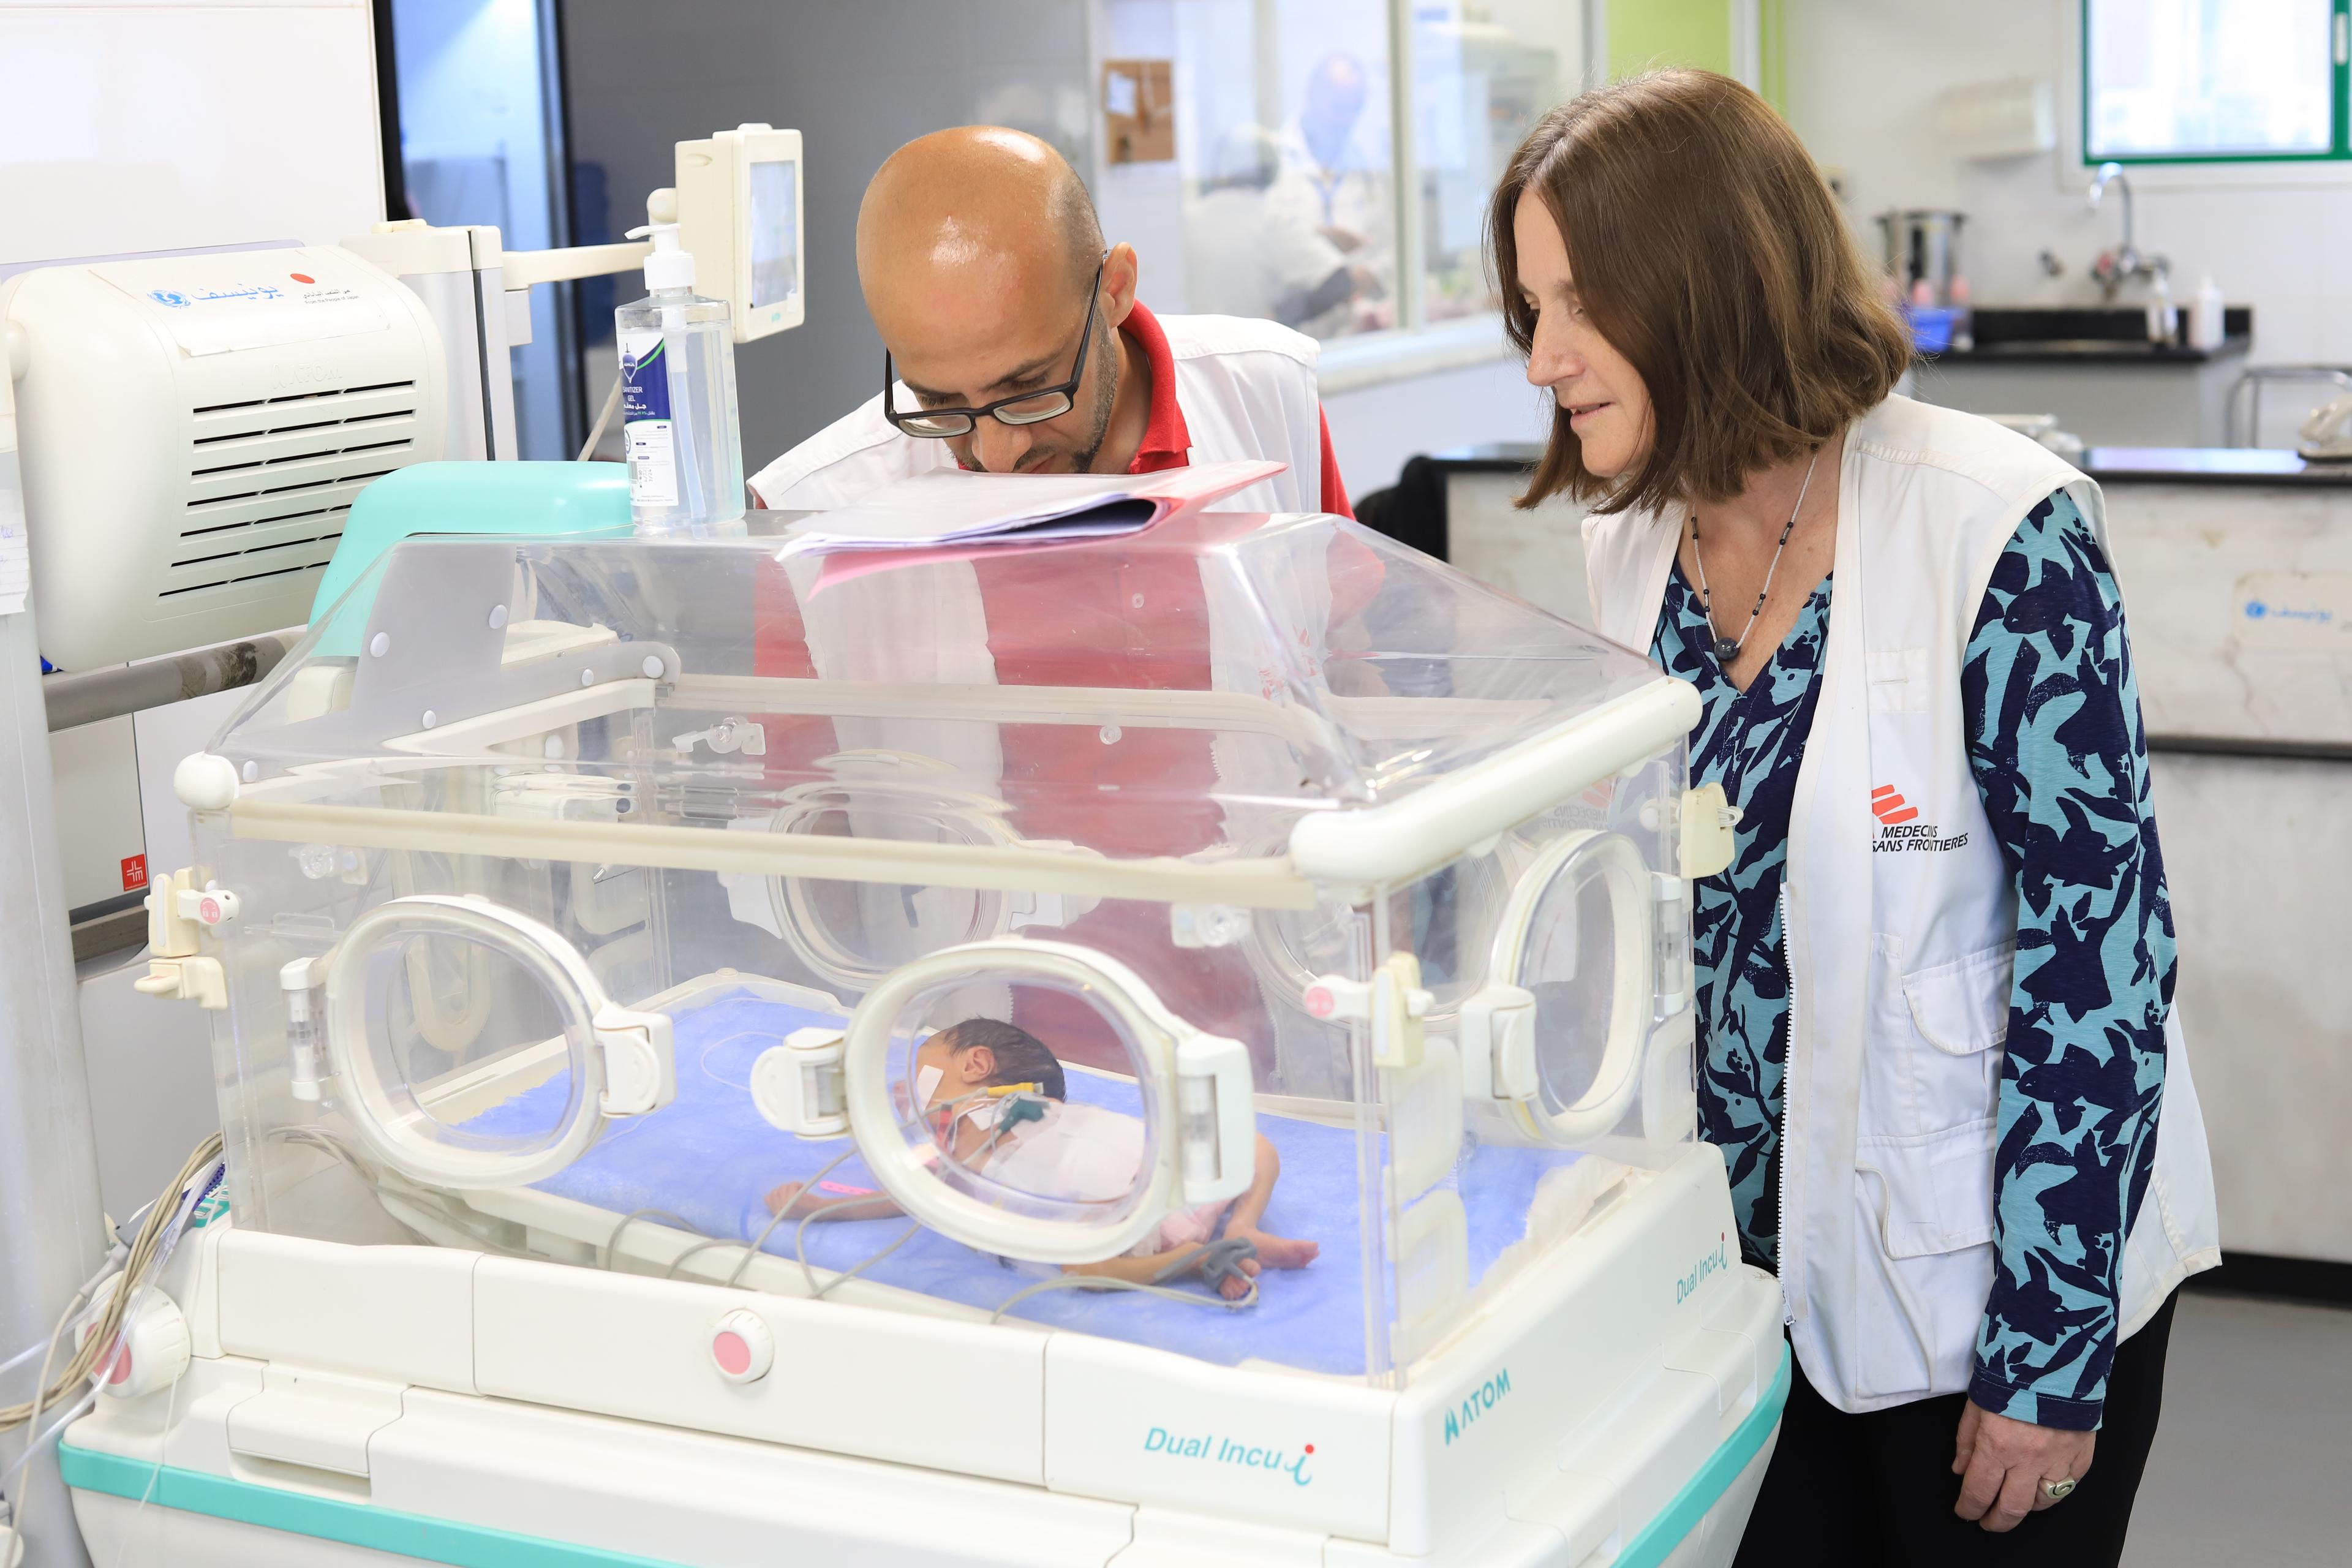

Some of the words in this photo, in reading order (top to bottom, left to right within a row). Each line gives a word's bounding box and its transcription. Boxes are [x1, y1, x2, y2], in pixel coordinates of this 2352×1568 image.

[190, 282, 284, 300] يونيسف
[1872, 840, 1904, 853] SANS
[1906, 832, 1969, 852] FRONTIERES
[1882, 825, 1938, 839] MEDECINS
[1677, 1264, 1697, 1305] Dual
[1144, 1427, 1213, 1459] Dual
